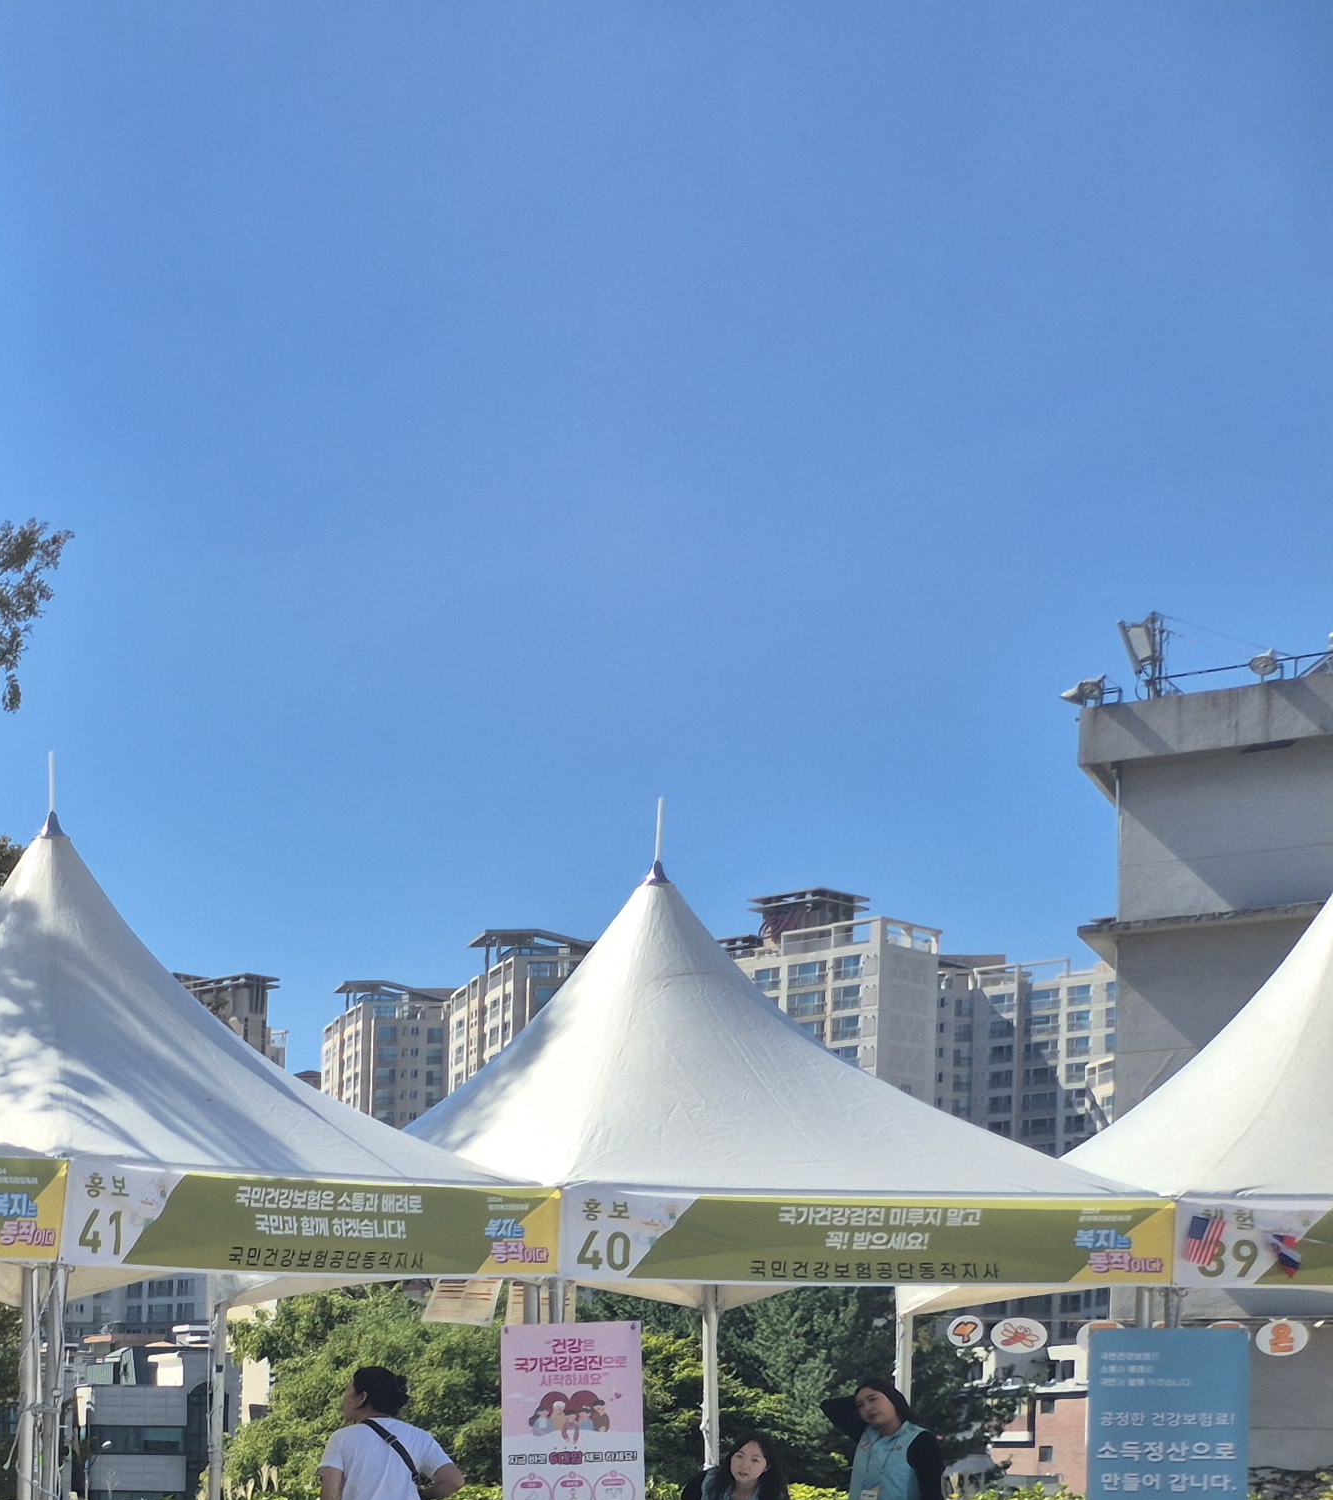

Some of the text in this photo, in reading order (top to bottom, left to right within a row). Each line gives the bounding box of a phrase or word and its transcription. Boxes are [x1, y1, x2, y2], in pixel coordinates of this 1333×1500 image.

[235, 1185, 424, 1214] 국민건강보험은 소통과 배려로
[254, 1213, 407, 1240] 국민과 함께 하겠습니다!
[779, 1206, 982, 1227] 국가건강검진 미루지 말고
[0, 1220, 56, 1247] 동작이다
[78, 1208, 123, 1256] 41
[484, 1218, 525, 1239] 복지는
[1074, 1229, 1132, 1249] 복지는
[577, 1230, 631, 1271] 40
[825, 1231, 930, 1250] 꼭! 받으세요!
[228, 1246, 425, 1270] 국민건강보험공단동작지사
[491, 1241, 550, 1263] 동작이다
[750, 1260, 1000, 1279] 국민건강보험공단동작지사
[1088, 1252, 1163, 1274] 동작이다
[1269, 1322, 1294, 1354] 온
[514, 1355, 628, 1373] 국가건강검진으로
[1099, 1411, 1236, 1427] 공정한 건강보험료!
[508, 1450, 638, 1465] 지금 바로 6대암 체크 하세요!
[1096, 1441, 1237, 1462] 소득정산으로
[1101, 1472, 1237, 1492] 만들어 갑니다.
